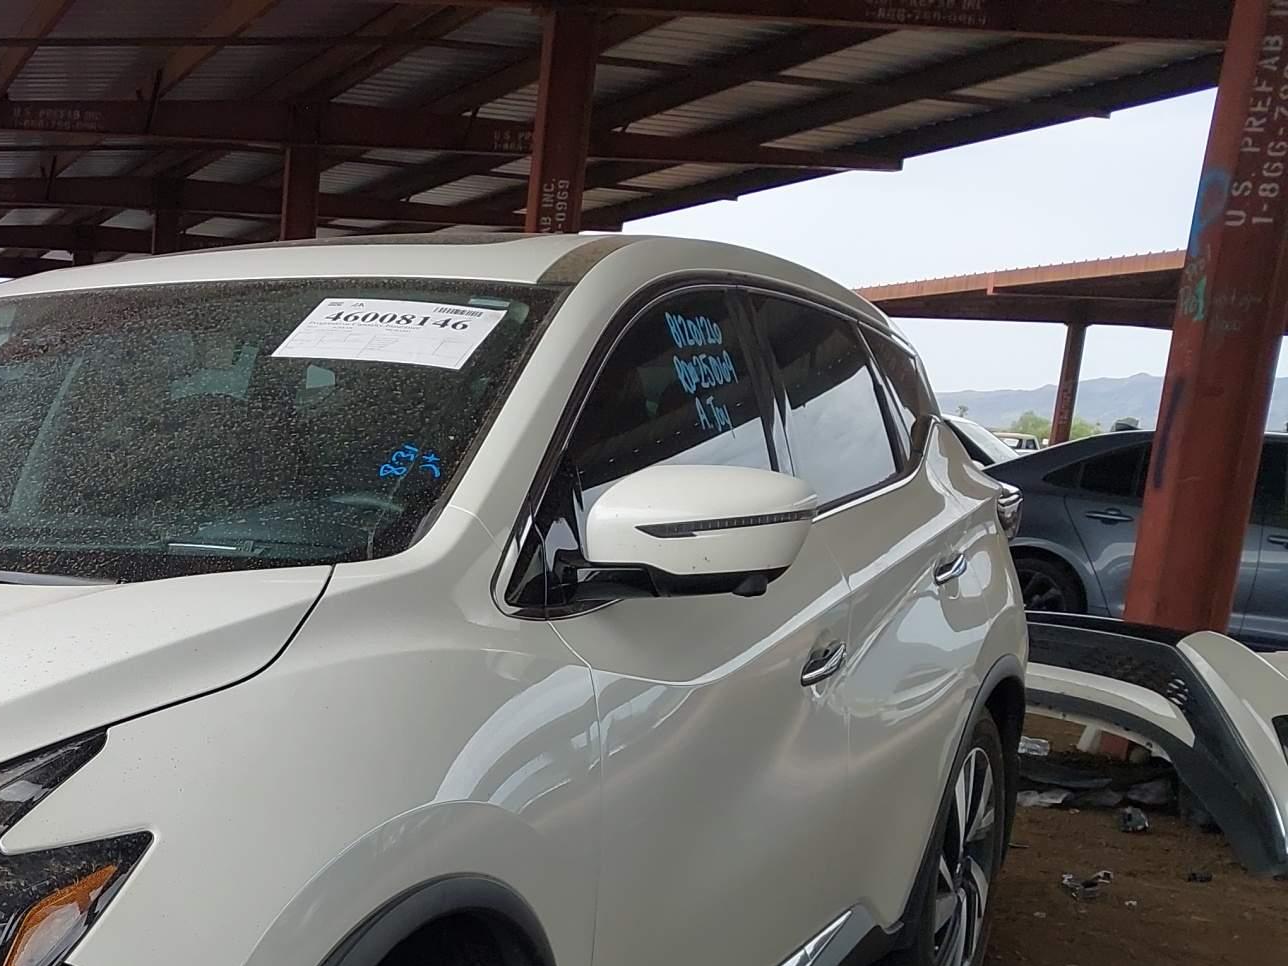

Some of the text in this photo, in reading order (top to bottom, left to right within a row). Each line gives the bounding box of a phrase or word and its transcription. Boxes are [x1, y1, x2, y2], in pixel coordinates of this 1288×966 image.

[1240, 34, 1284, 152] PREFAB
[542, 178, 557, 208] INC.
[553, 179, 570, 233] -0969
[325, 310, 472, 331] 46008146
